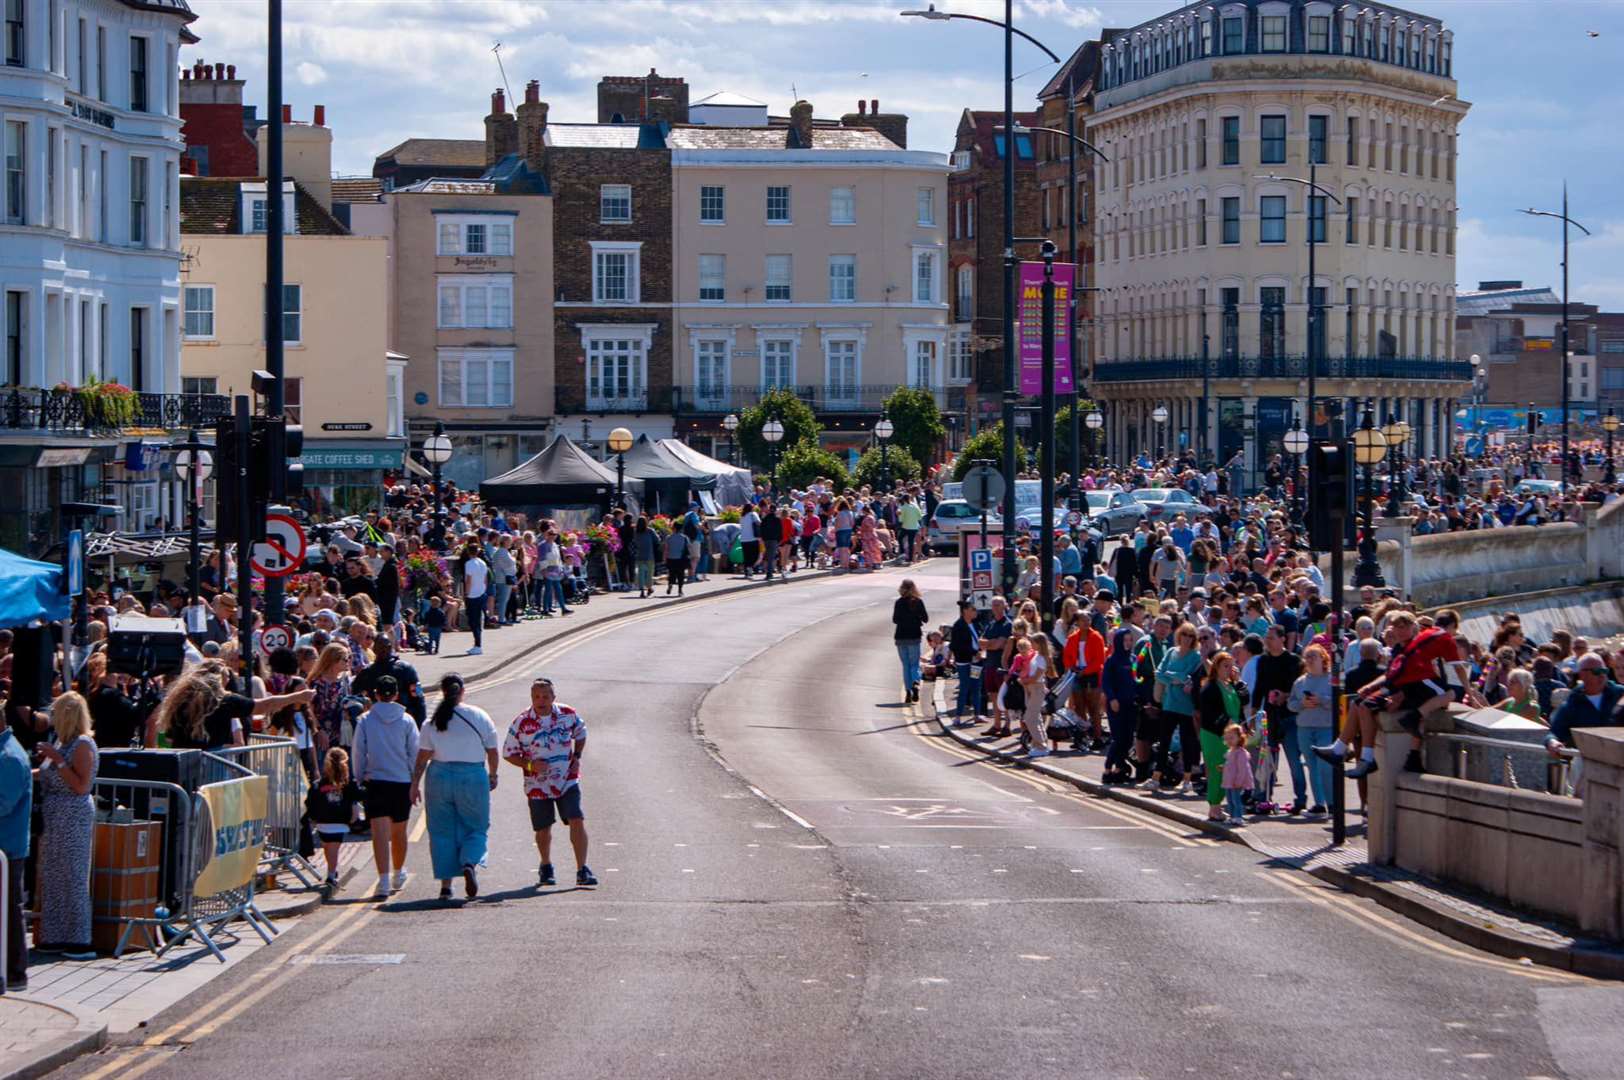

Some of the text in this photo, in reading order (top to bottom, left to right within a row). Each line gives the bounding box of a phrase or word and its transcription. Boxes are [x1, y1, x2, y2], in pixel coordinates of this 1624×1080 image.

[325, 454, 353, 464] COFFEE
[355, 454, 374, 464] SHED
[975, 552, 988, 568] P
[265, 633, 289, 648] 20
